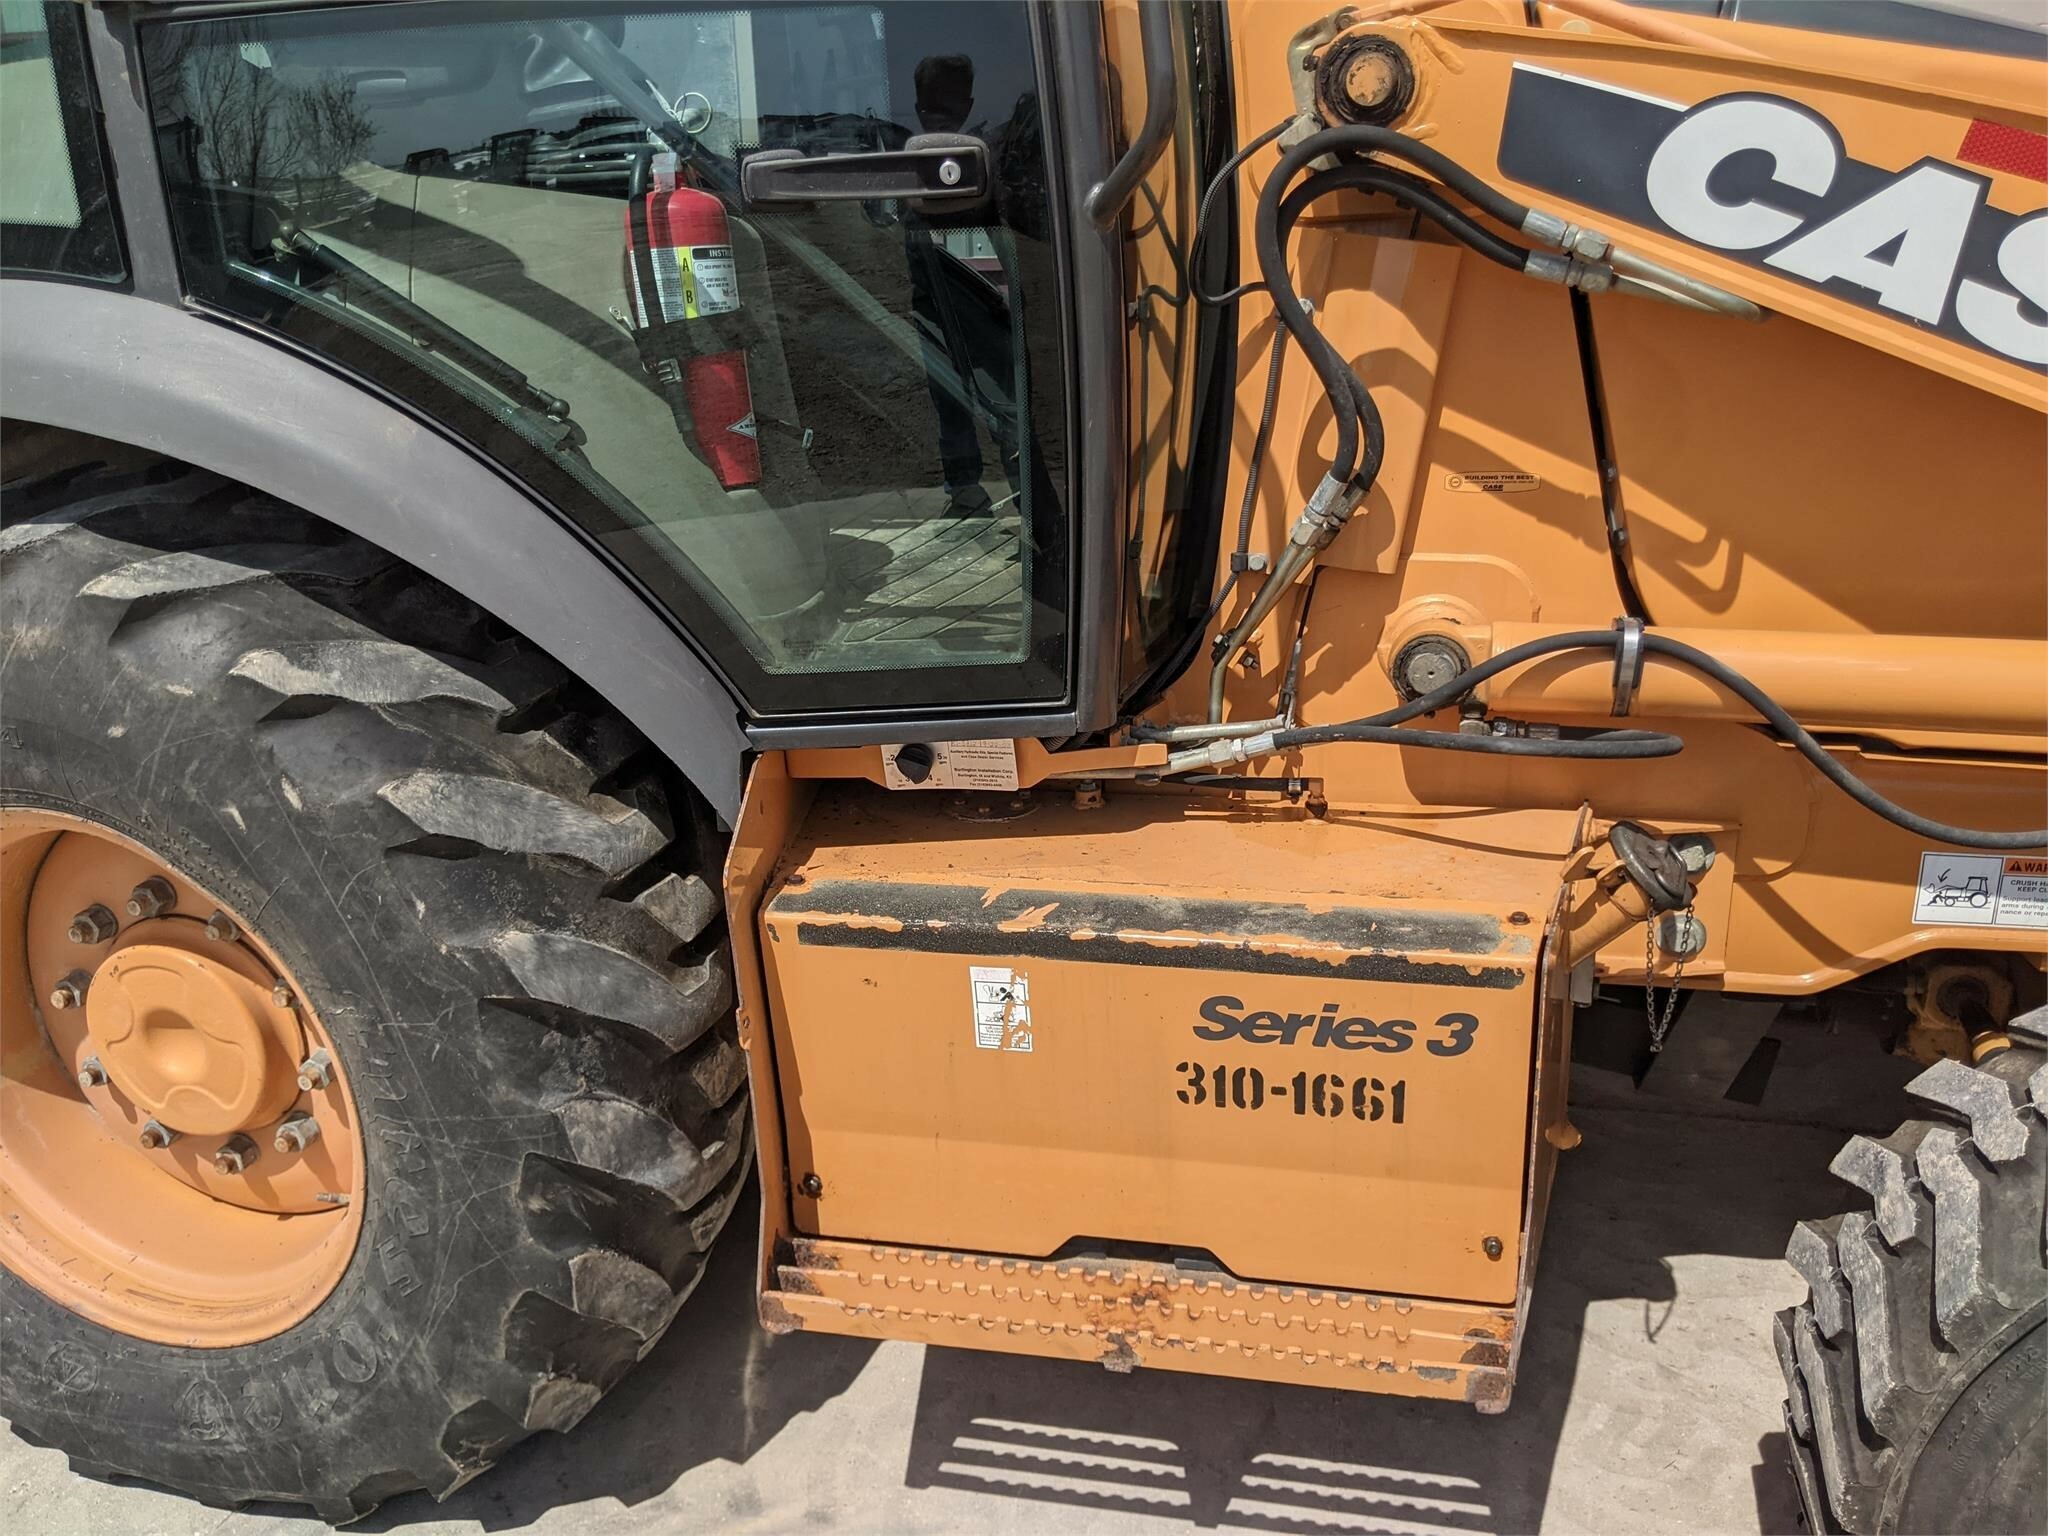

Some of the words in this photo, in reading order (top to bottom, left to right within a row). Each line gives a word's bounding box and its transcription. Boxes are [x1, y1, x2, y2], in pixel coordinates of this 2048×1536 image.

[682, 257, 690, 272] A
[686, 290, 694, 304] B
[937, 752, 943, 760] 5
[1192, 995, 1418, 1054] Series
[1426, 1012, 1479, 1057] 3
[1175, 1061, 1407, 1124] 310-1661
